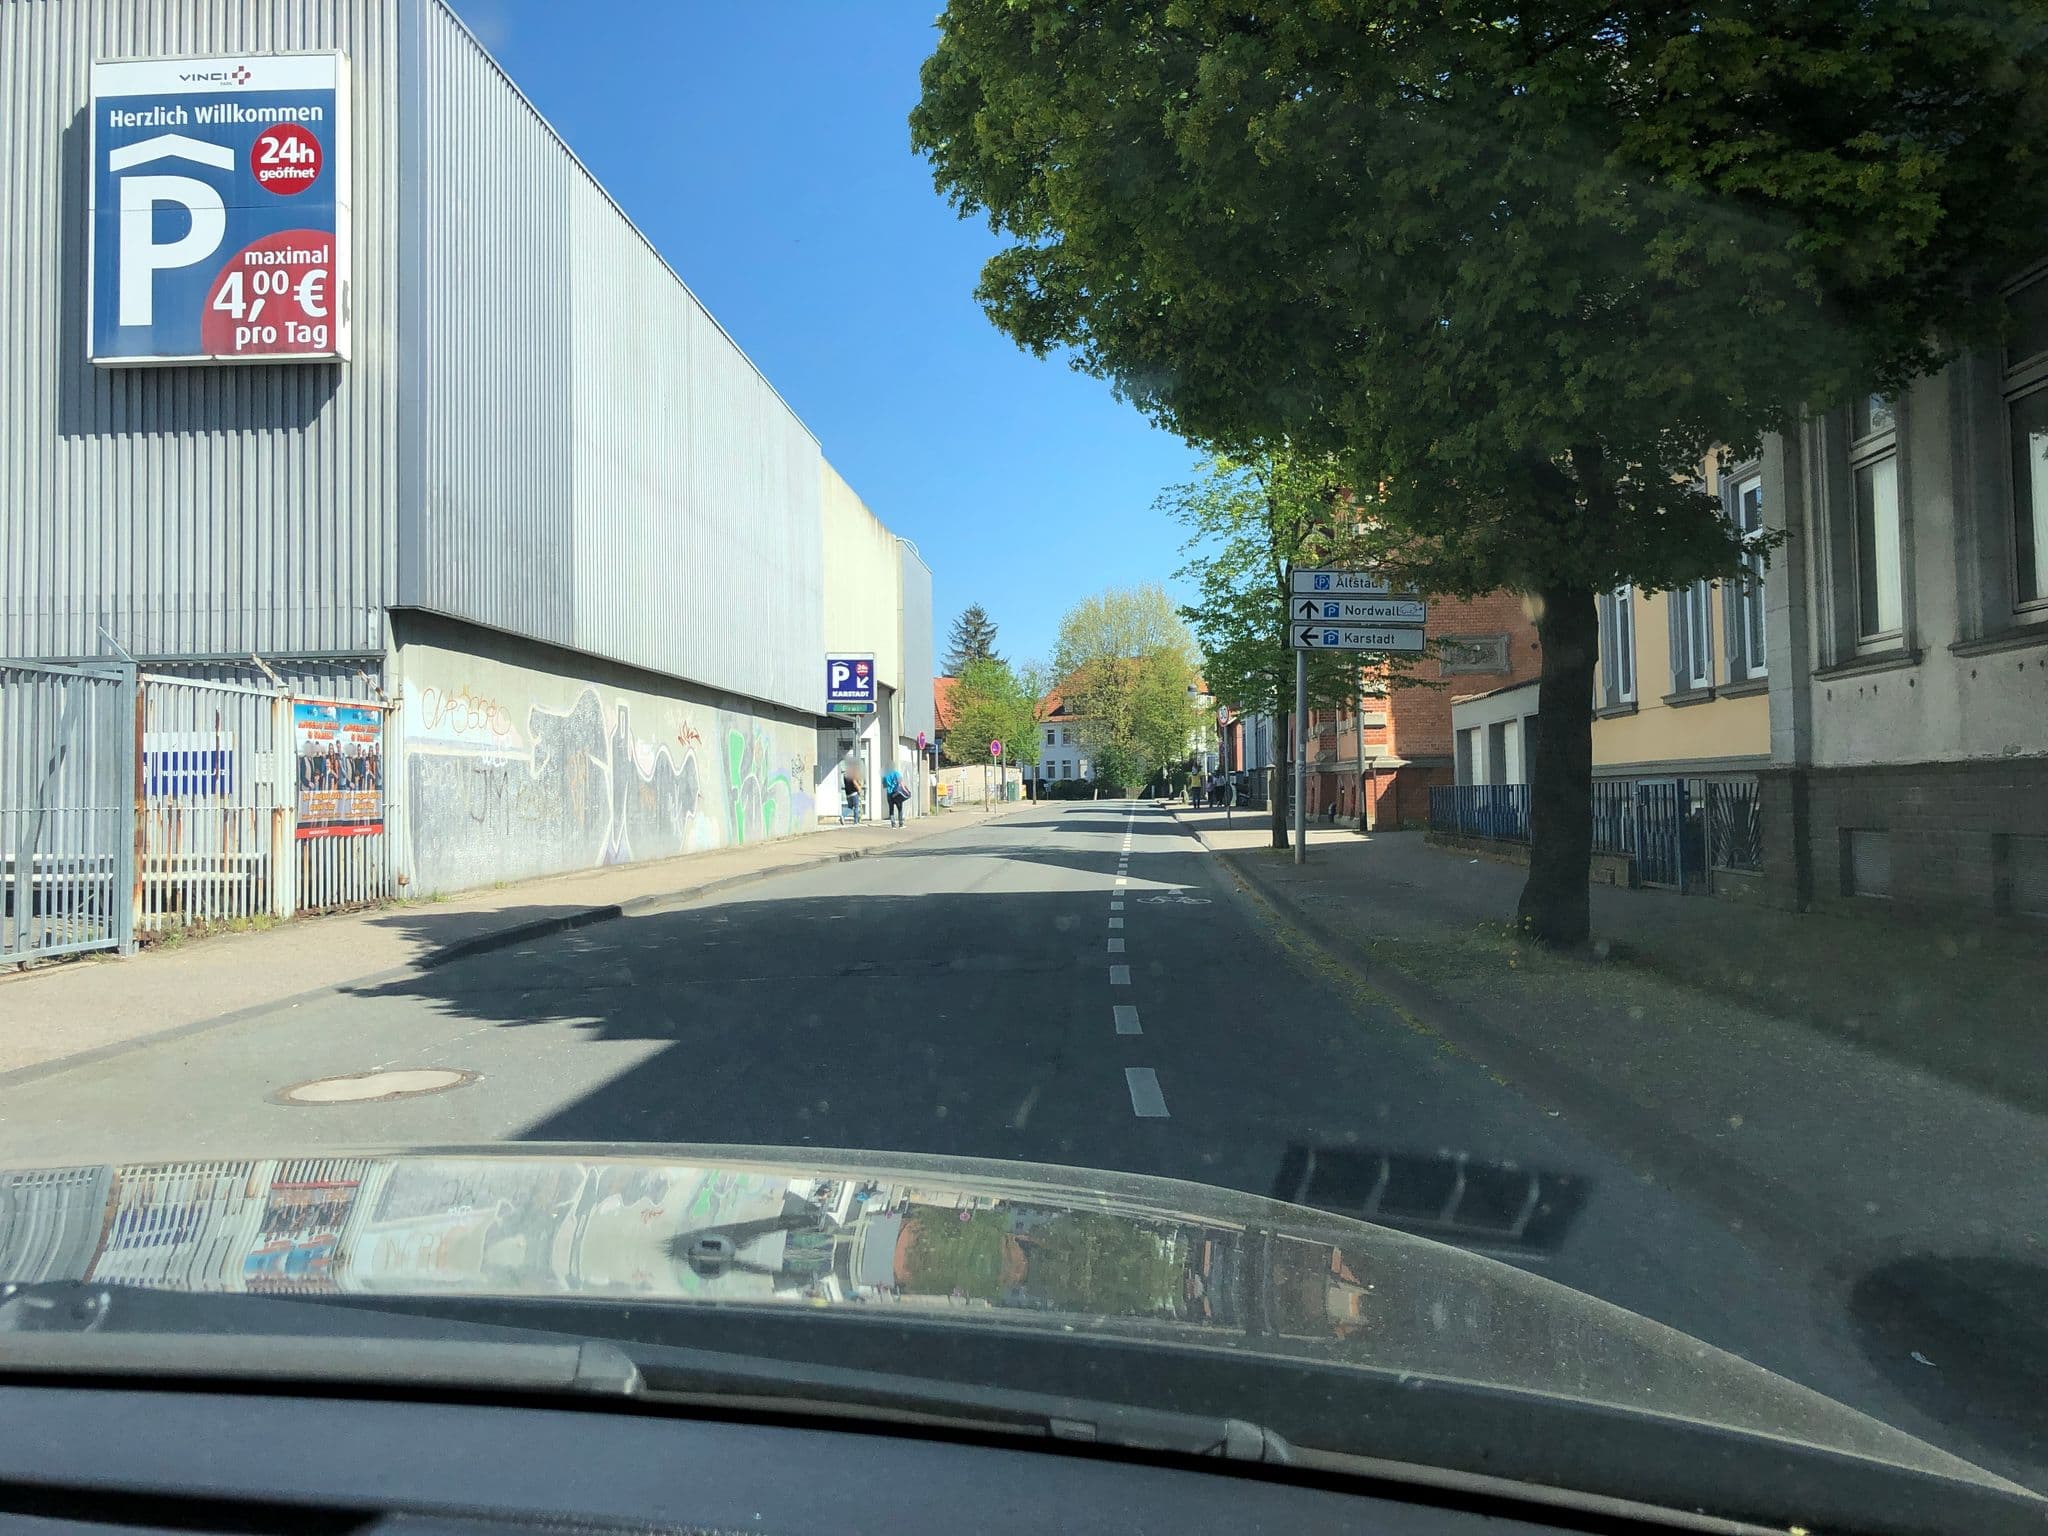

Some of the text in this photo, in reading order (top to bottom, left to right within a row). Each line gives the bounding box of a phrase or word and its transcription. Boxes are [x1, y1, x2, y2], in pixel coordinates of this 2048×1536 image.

[179, 72, 228, 82] VINCI
[110, 103, 324, 128] Herzlich Willkommen
[259, 136, 315, 164] 24h
[259, 165, 316, 182] geöffnet
[119, 175, 227, 327] P
[244, 244, 329, 266] maximal
[235, 320, 328, 352] pro Tag
[1335, 576, 1384, 589] Altsta
[1345, 604, 1400, 617] Nordwall
[1344, 632, 1395, 645] Karstadt
[832, 666, 850, 688] P
